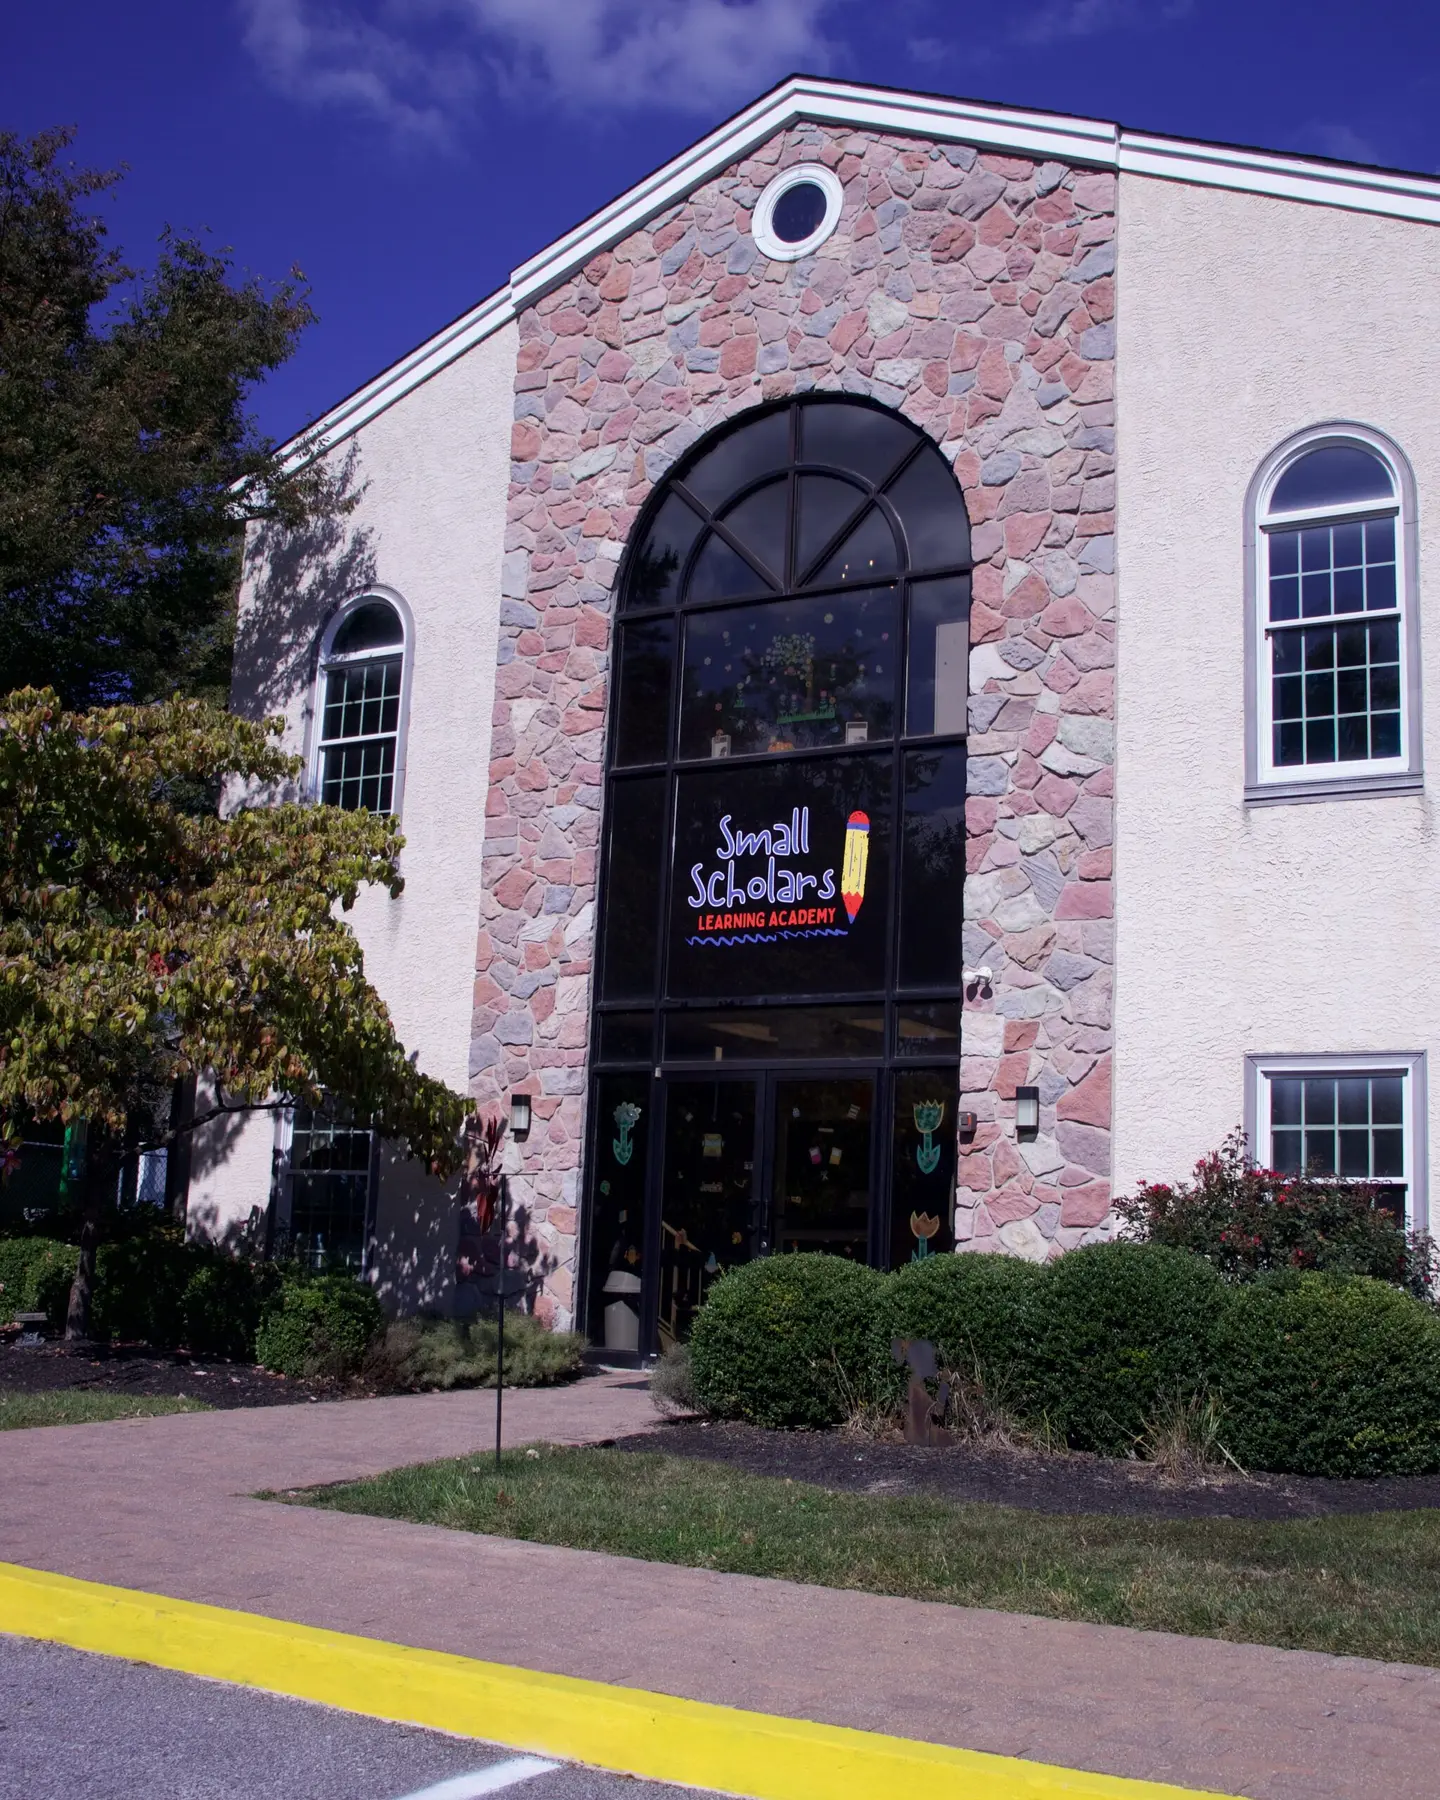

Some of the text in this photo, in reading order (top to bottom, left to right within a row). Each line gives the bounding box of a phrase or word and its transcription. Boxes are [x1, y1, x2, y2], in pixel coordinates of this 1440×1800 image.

[717, 807, 809, 859] Small
[688, 856, 835, 908] Scholars
[698, 908, 836, 931] LEARNING ACADEMY
